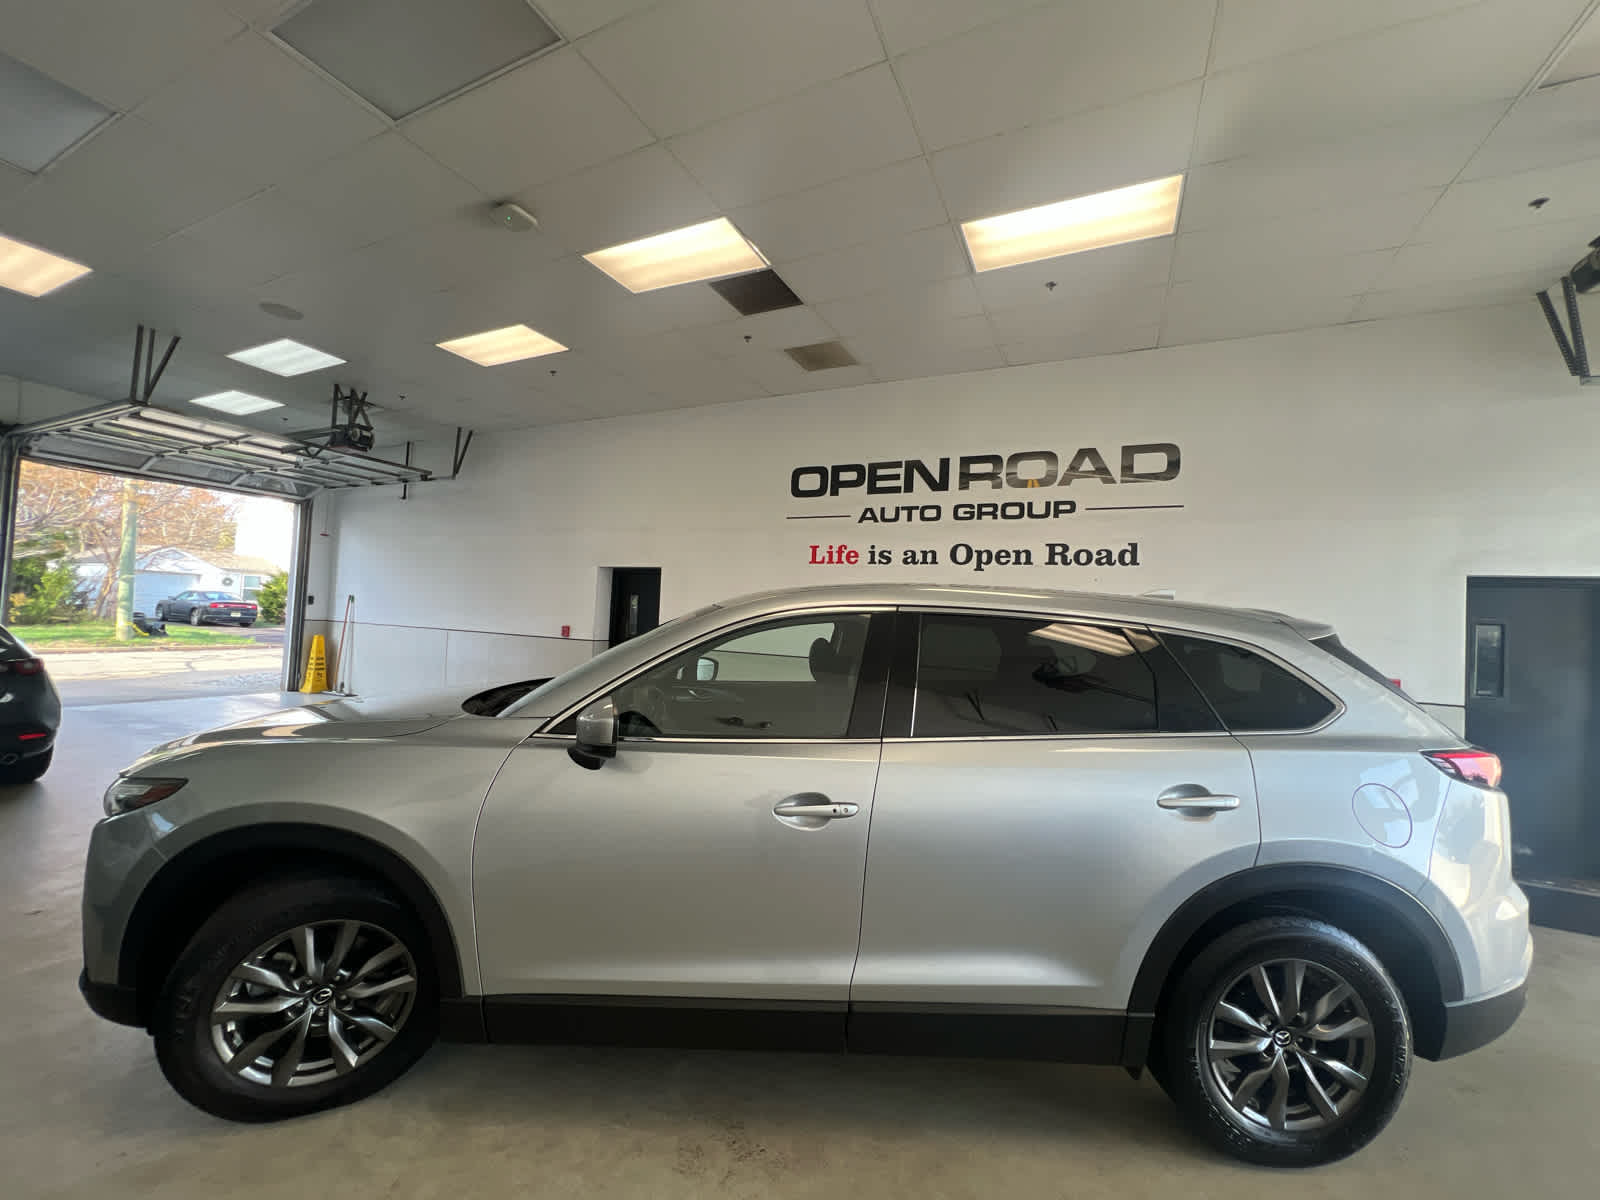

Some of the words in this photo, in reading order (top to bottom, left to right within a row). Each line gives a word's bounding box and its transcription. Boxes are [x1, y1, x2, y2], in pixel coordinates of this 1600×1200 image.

[790, 457, 950, 498] OPEN
[957, 443, 1181, 492] ROAD
[858, 504, 942, 524] AUTO
[952, 500, 1077, 521] GROUP
[808, 544, 859, 565] Life
[867, 544, 893, 566] is
[901, 549, 939, 566] an
[949, 543, 1034, 572] Open
[1044, 542, 1140, 567] Road
